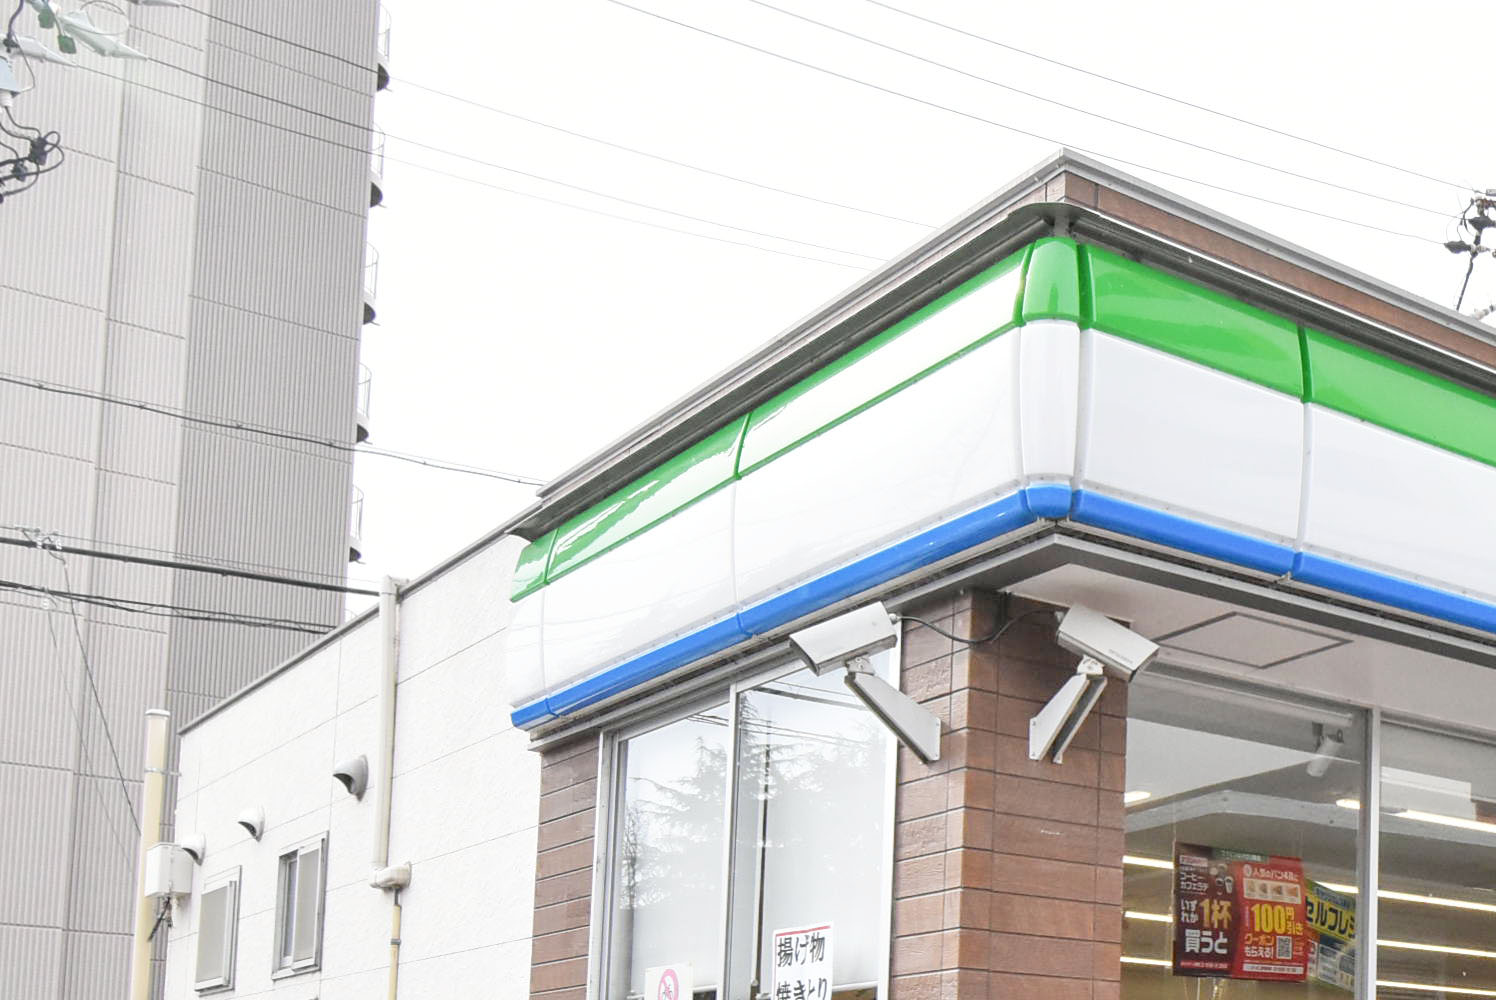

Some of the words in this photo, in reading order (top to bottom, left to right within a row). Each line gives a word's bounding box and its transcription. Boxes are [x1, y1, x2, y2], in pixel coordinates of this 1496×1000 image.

[1200, 899, 1232, 928] 1杯
[777, 932, 826, 967] 揚げ物
[1185, 928, 1228, 954] 買うと
